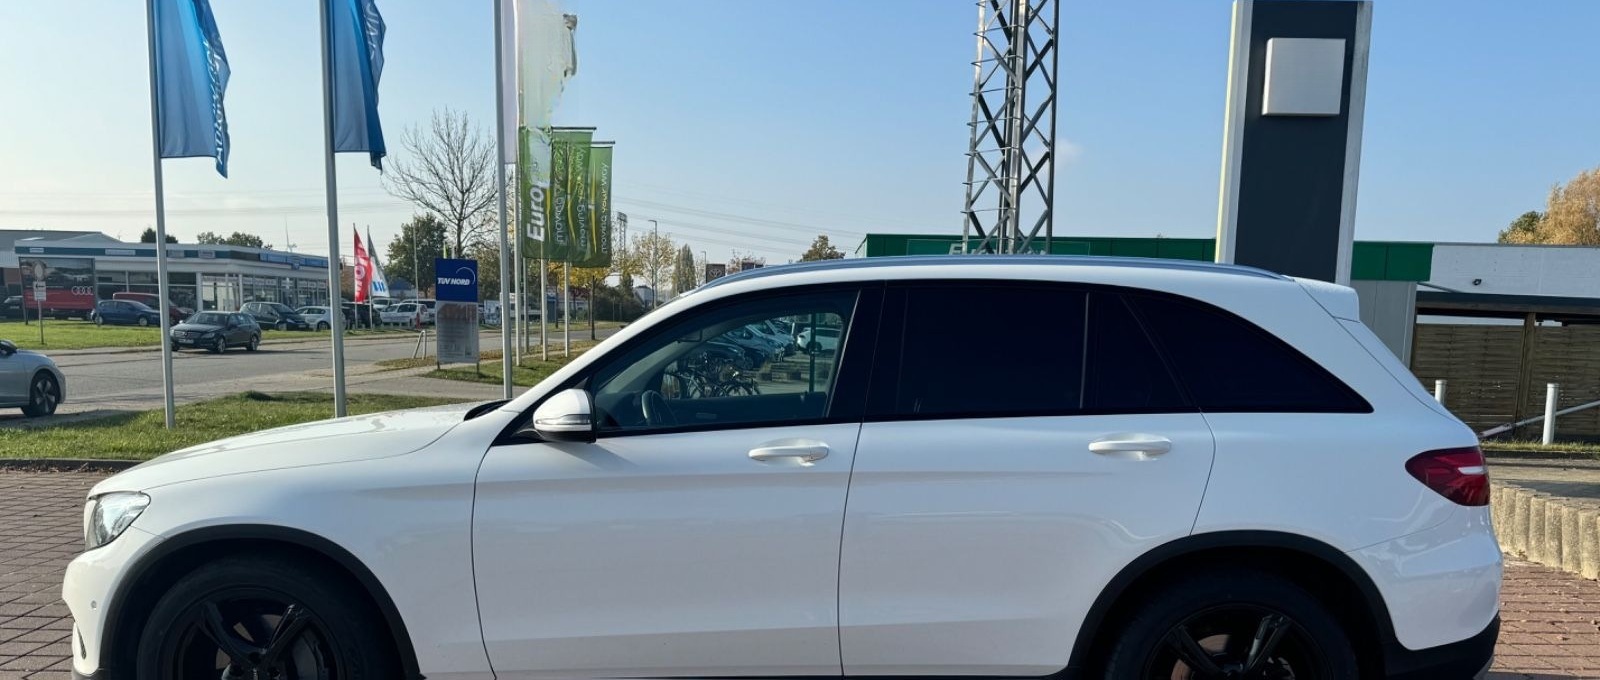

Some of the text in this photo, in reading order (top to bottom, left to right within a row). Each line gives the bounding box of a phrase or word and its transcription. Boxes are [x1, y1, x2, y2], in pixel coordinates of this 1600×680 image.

[576, 204, 586, 247] moving
[600, 162, 609, 254] moving your way
[450, 277, 471, 286] NORD
